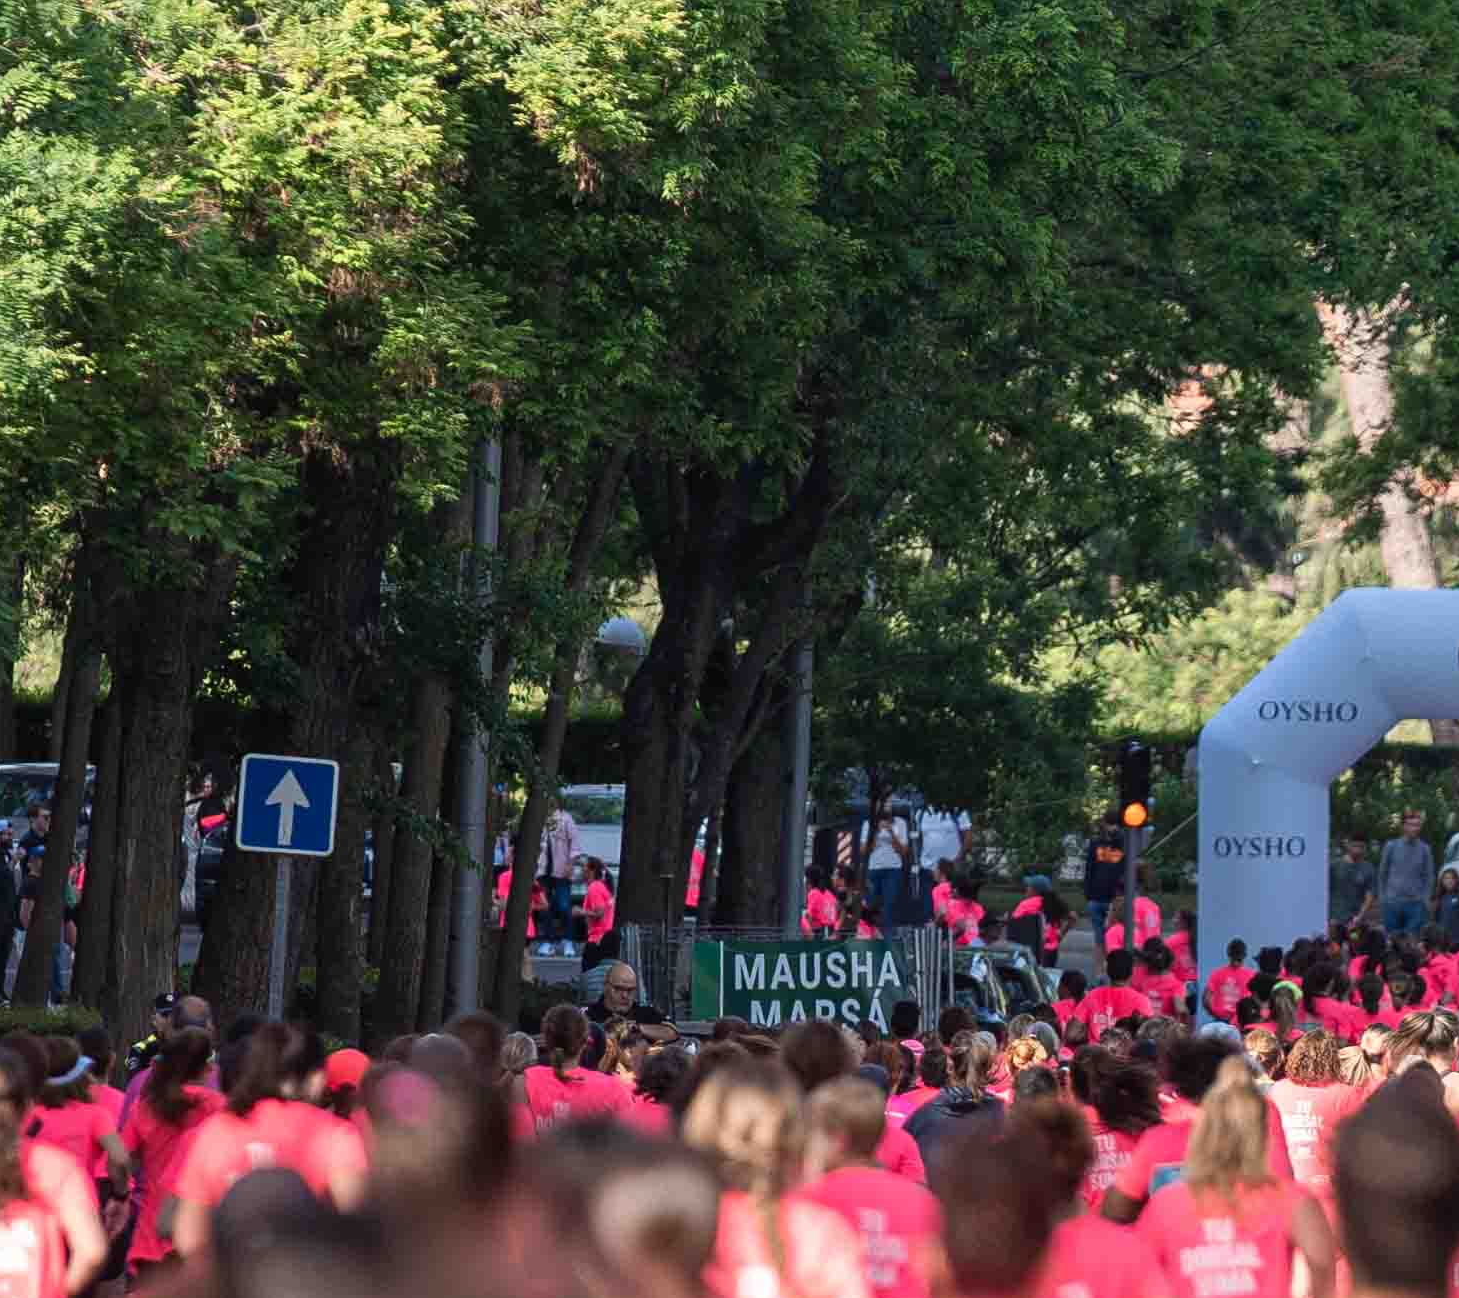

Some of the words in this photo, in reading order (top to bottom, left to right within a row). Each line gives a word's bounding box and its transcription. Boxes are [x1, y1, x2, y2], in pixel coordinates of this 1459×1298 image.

[1259, 701, 1358, 722] OYSHO
[1214, 836, 1306, 857] OYSHO
[734, 951, 901, 991] MAUSHA
